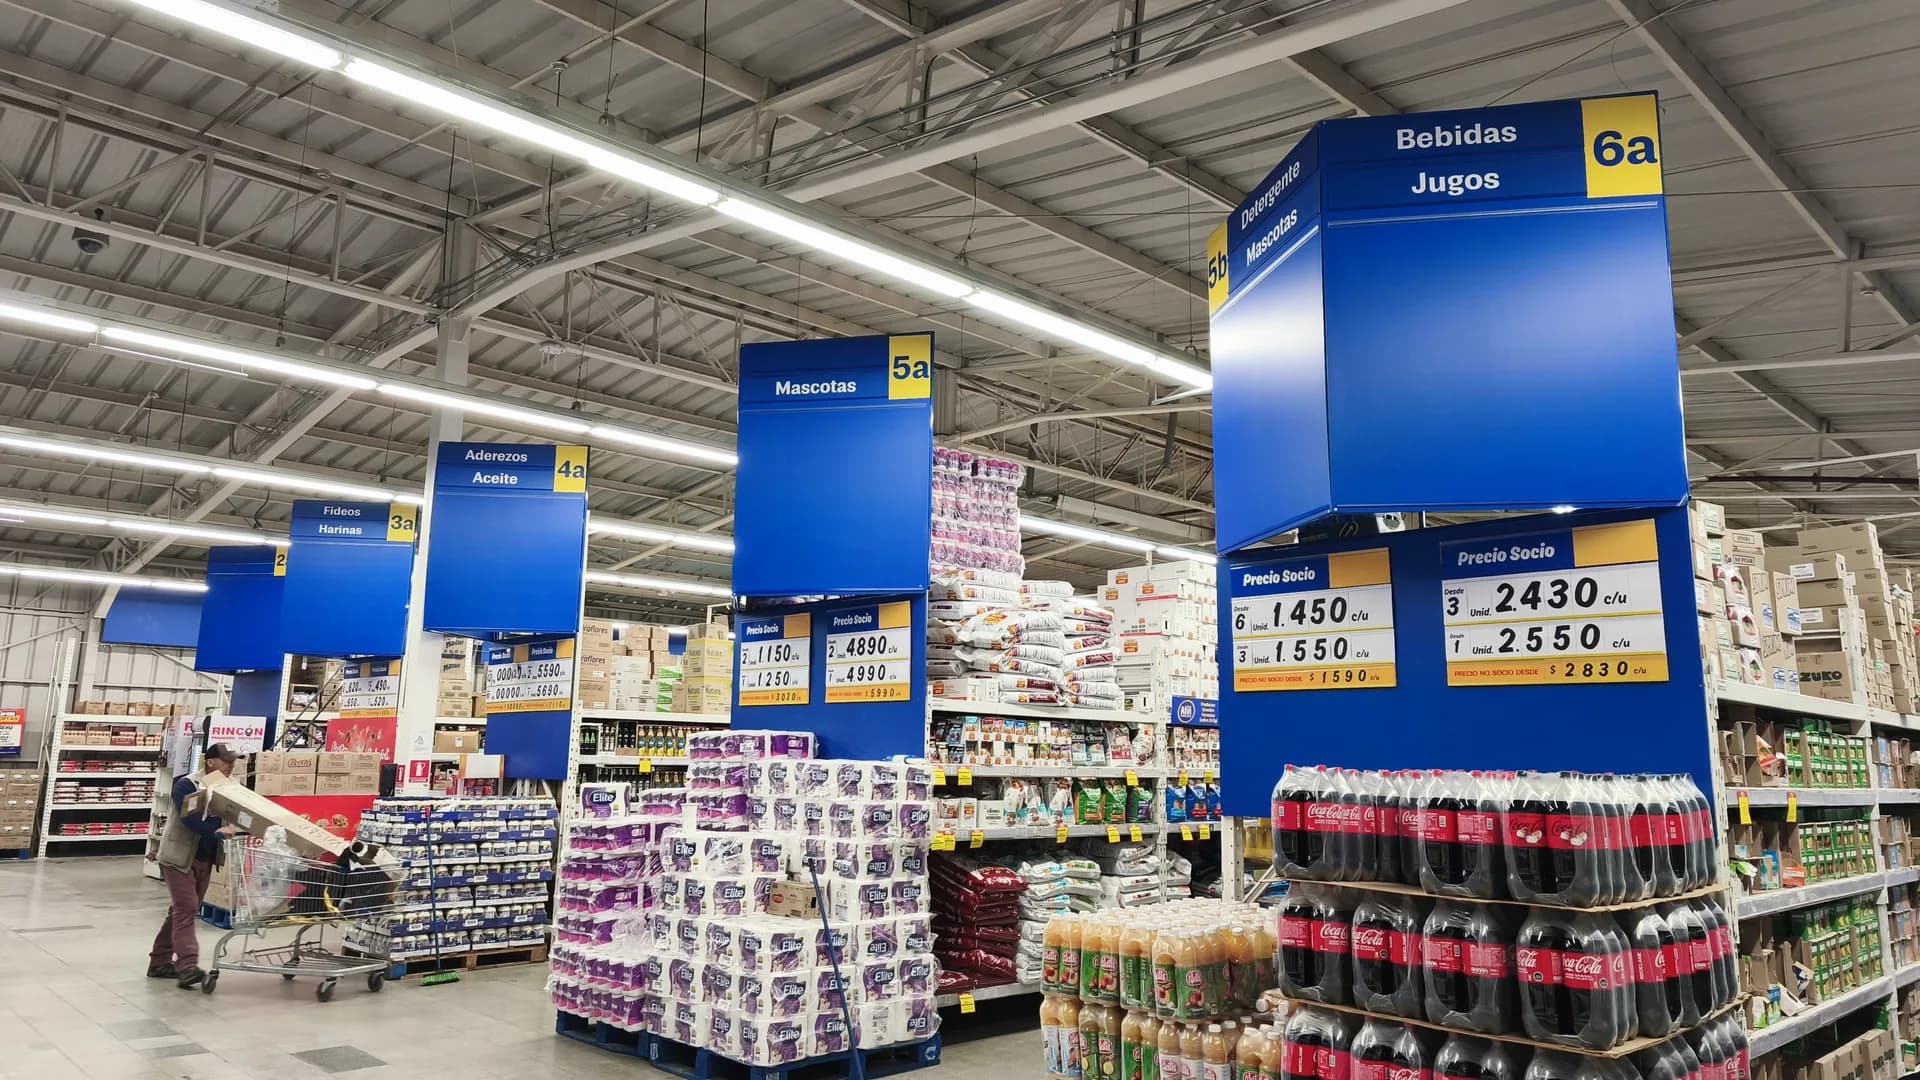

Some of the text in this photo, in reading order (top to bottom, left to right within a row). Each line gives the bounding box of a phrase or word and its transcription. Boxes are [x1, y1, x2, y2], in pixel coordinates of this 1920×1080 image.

[1396, 122, 1518, 151] Bebidas
[1592, 129, 1658, 167] 6a
[1411, 171, 1501, 196] Jugos
[1241, 161, 1301, 230] Detergente
[1246, 208, 1298, 267] Mascotas
[1208, 250, 1227, 289] 5b
[892, 355, 930, 380] 5a
[775, 379, 857, 396] Mascotas
[464, 448, 529, 464] Aderezos
[557, 460, 585, 479] 4a
[472, 471, 518, 486] Aceite
[323, 505, 361, 518] Fideos
[318, 523, 363, 536] Harinas
[390, 515, 414, 531] 3a
[276, 553, 288, 567] 2
[1457, 542, 1556, 566] Precio Socio
[1242, 566, 1316, 587] Precio Socio
[1444, 588, 1464, 596] Desde
[1446, 577, 1627, 617] 3 Unid. 2.430 c/u
[833, 612, 873, 627] Precio Socio
[1235, 596, 1369, 632] 6 Unid. 1.450 c/u
[745, 623, 779, 636] Precio Socio
[1454, 623, 1631, 655] 1 Unid. 2.550 c/u
[828, 645, 835, 658] 2
[1239, 637, 1370, 664] 3 Unid. 1.550 c/u
[1322, 669, 1367, 684] 1590
[1492, 669, 1515, 677] SOCIO
[1549, 664, 1557, 675] $
[1800, 670, 1843, 682] ZUKO
[592, 792, 615, 803] Elite
[873, 811, 892, 822] Elite
[675, 844, 694, 855] Elite
[761, 845, 781, 855] Elite
[869, 862, 887, 871] Elite
[687, 886, 704, 897] Elite
[724, 888, 744, 899] Elite
[868, 891, 887, 901] Elite
[903, 887, 920, 897] Elite
[782, 940, 802, 952] Elite
[831, 936, 847, 946] lite
[869, 942, 887, 953] Elite
[911, 966, 930, 977] Elite
[1562, 955, 1604, 975] ca-Cola
[716, 974, 730, 988] Elite
[874, 970, 894, 982] Elite
[783, 984, 804, 996] Elite
[826, 1021, 846, 1033] Elite
[909, 1017, 926, 1028] Elite
[779, 1029, 800, 1041] Elite
